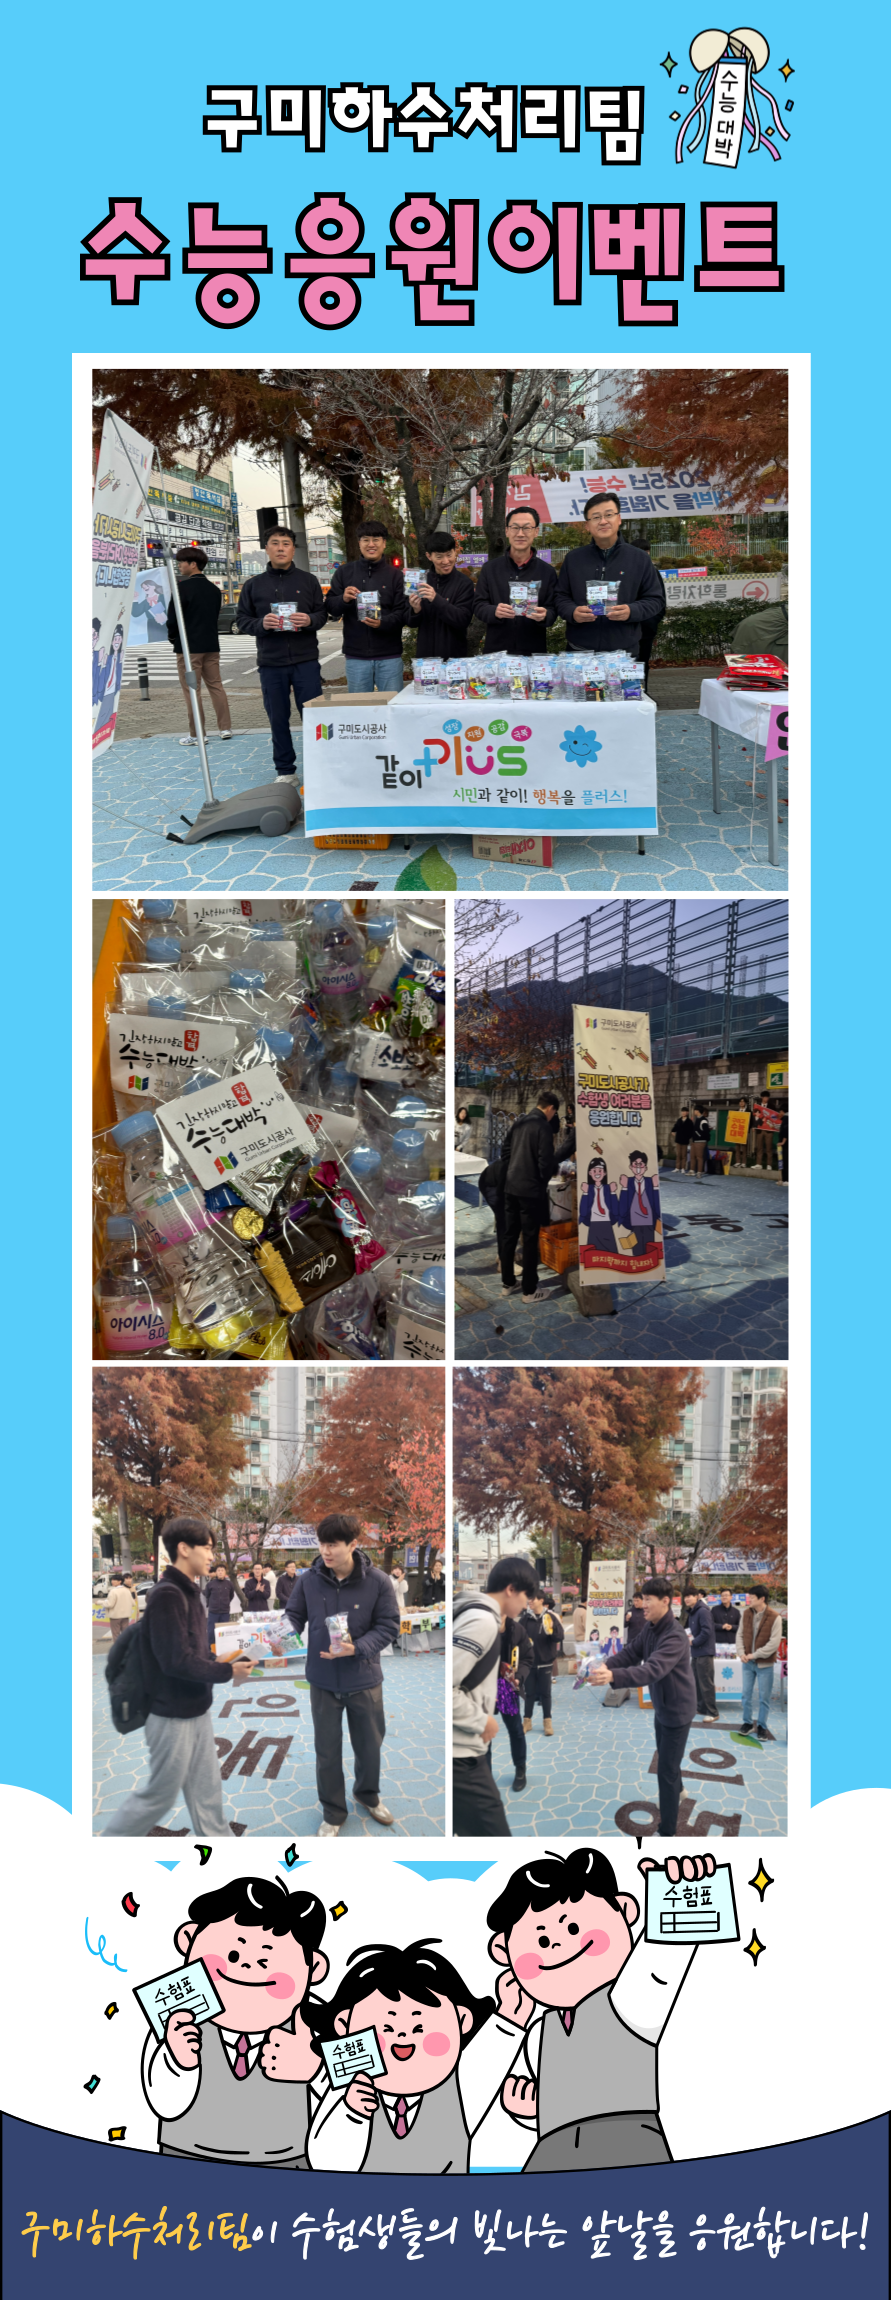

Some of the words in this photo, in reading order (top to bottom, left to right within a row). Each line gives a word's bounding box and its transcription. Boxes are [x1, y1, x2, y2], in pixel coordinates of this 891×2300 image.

[338, 723, 388, 735] 구미도시공사
[375, 755, 422, 789] 같이
[453, 787, 491, 803] 시민과
[496, 788, 528, 804] 같이!
[532, 788, 576, 805] 행복을
[581, 789, 627, 805] 플러스!
[321, 972, 357, 985] 아이시스
[601, 1019, 637, 1029] 구미도시공사
[119, 1043, 198, 1069] 수능대박
[578, 1073, 650, 1092] 구미도시공사가
[577, 1091, 609, 1108] 수험생
[610, 1093, 652, 1110] 여러분을
[589, 1109, 643, 1127] 응원합니다
[186, 1107, 268, 1154] 수능대박
[239, 1126, 294, 1156] 구미도시공사
[270, 1136, 297, 1153] Corporation
[110, 1314, 164, 1332] 아이시스
[148, 1328, 164, 1340] 8.0
